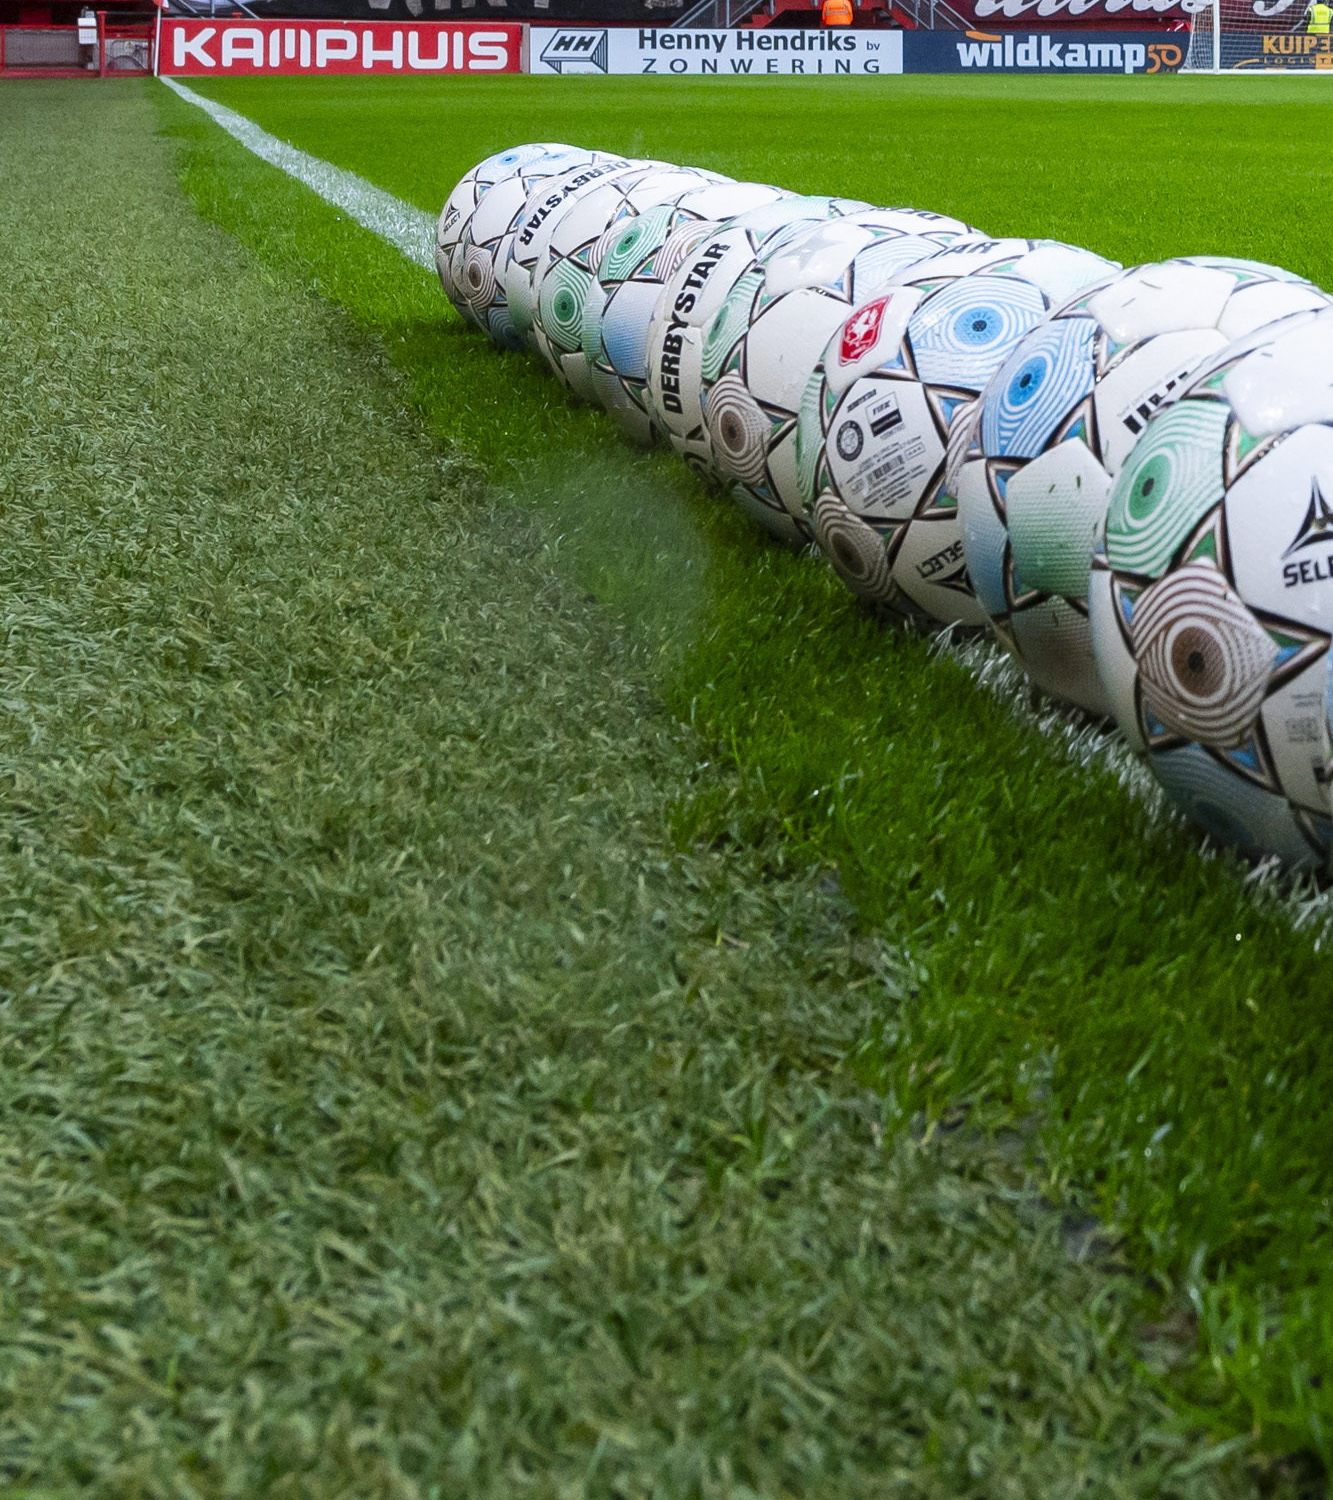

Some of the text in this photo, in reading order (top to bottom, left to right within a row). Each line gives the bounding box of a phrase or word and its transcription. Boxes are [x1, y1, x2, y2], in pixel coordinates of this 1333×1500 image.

[173, 27, 509, 70] KAMPHUIS
[638, 29, 881, 53] Henny Hendriks bv
[957, 35, 1145, 74] wildkamp
[642, 58, 880, 74] ZONWERING
[660, 242, 731, 415] DERBYSTAR
